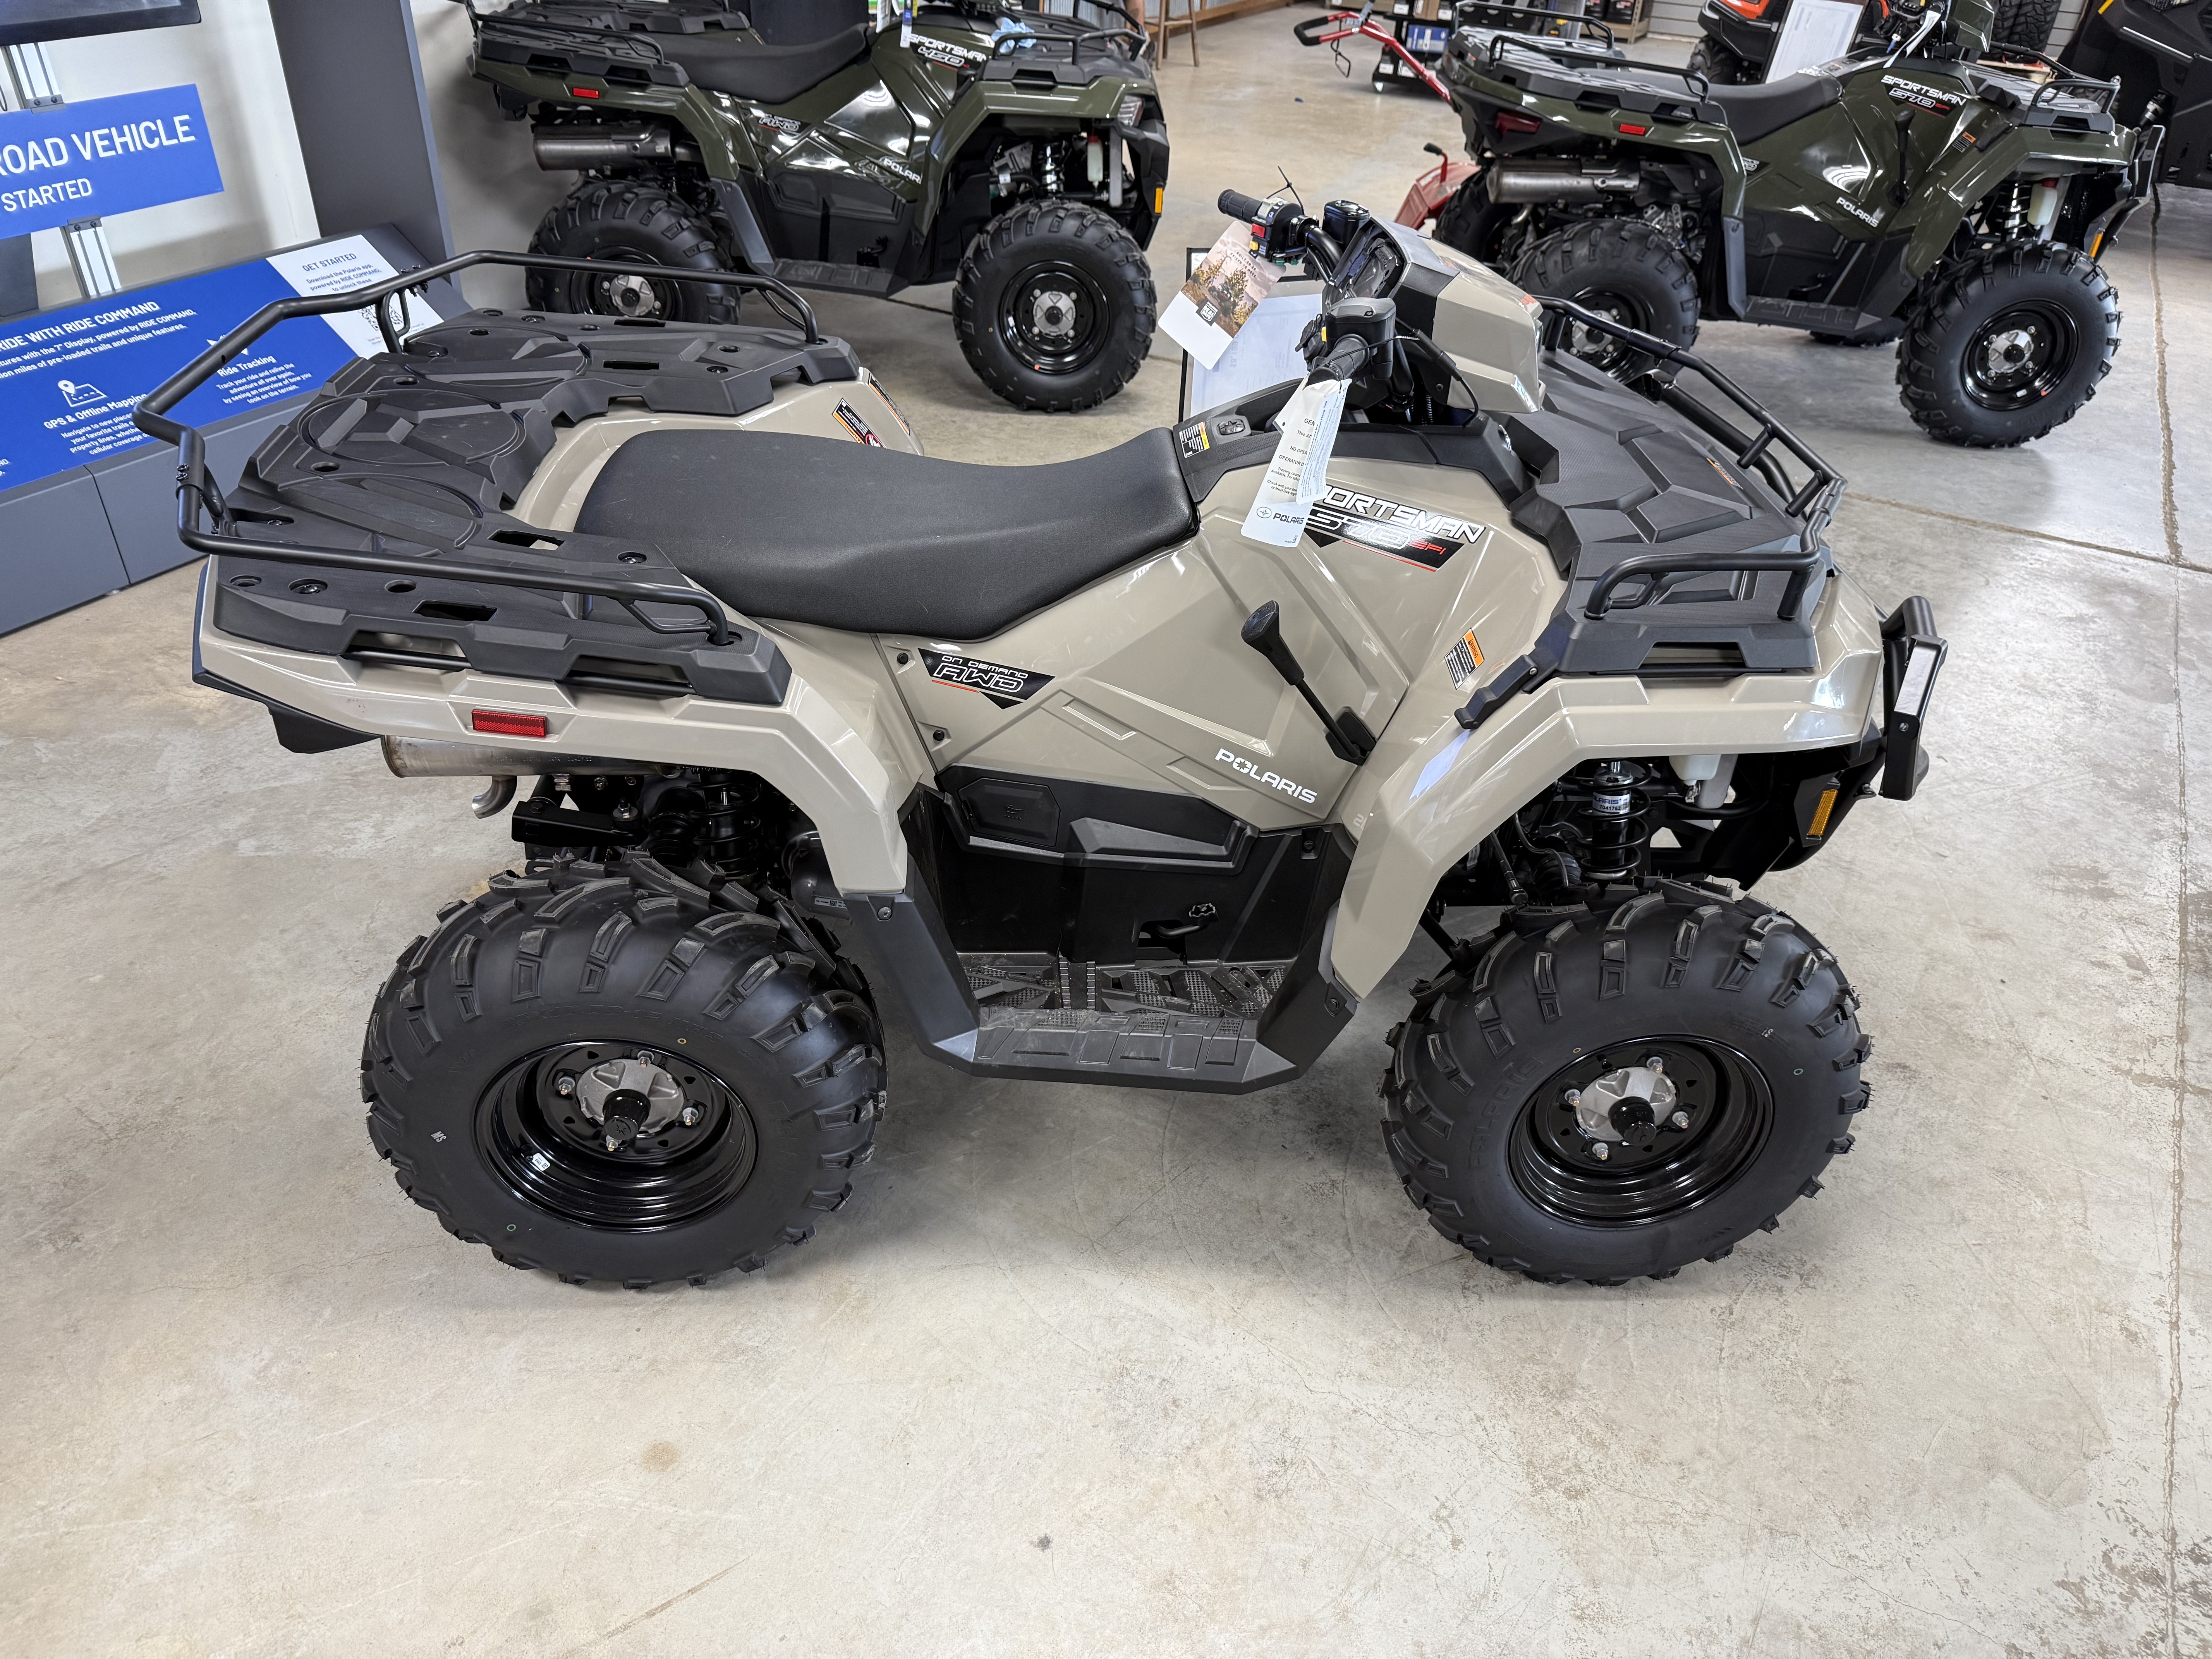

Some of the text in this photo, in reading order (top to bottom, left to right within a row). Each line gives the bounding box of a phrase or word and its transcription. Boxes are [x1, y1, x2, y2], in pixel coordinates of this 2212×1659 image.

[1881, 75, 1966, 106] SPORTSMAN
[1889, 88, 1936, 108] 570
[0, 114, 196, 176] OAD VEHICLE
[883, 158, 922, 185] POLARI
[1, 178, 92, 212] STARTED
[1836, 197, 1879, 228] POLARIS
[302, 253, 357, 271] GET STARTED
[306, 273, 335, 284] Download
[342, 265, 363, 275] Polaris
[310, 281, 338, 292] powered
[338, 282, 357, 290] unlock
[24, 326, 65, 342] WITH
[62, 317, 96, 333] RIDE
[94, 301, 161, 325] COMMAND
[1202, 305, 1216, 318] DEAL
[14, 363, 38, 374] miles
[37, 360, 47, 368] of
[46, 348, 92, 366] pre-loaded
[90, 343, 113, 353] trails
[112, 339, 127, 350] and
[127, 333, 153, 345] unique
[153, 323, 187, 337] features.
[21, 350, 41, 360] with
[40, 346, 56, 355] the
[64, 337, 96, 349] Display,
[95, 327, 128, 342] powered
[127, 324, 139, 335] by
[137, 319, 157, 330] RIDE
[217, 356, 277, 377] Ride Tracking
[216, 381, 235, 390] Track
[234, 378, 247, 386] your
[269, 366, 286, 374] relive
[229, 382, 258, 394] adventure
[232, 392, 252, 401] seeing
[258, 381, 283, 393] overview
[247, 395, 262, 404] took
[44, 393, 148, 429] GPS & Offline Mapping
[60, 424, 92, 438] Navigate
[70, 427, 141, 453] property lines, whethe
[71, 435, 86, 445] your
[86, 427, 113, 439] favorite
[111, 422, 129, 431] trails
[89, 444, 114, 455] cellular
[113, 434, 143, 448] coverage
[1279, 455, 1302, 465] OPERATOR
[1278, 467, 1291, 476] Training
[1273, 513, 1304, 524] POLARIS
[1323, 485, 1486, 543] ORTSMAN
[1306, 505, 1411, 550] 570
[1410, 539, 1446, 555] EFI
[941, 655, 1028, 678] ON DEMAND
[933, 663, 1024, 693] AWD
[1215, 748, 1317, 804] POLARIS
[1594, 796, 1619, 804] LARIS
